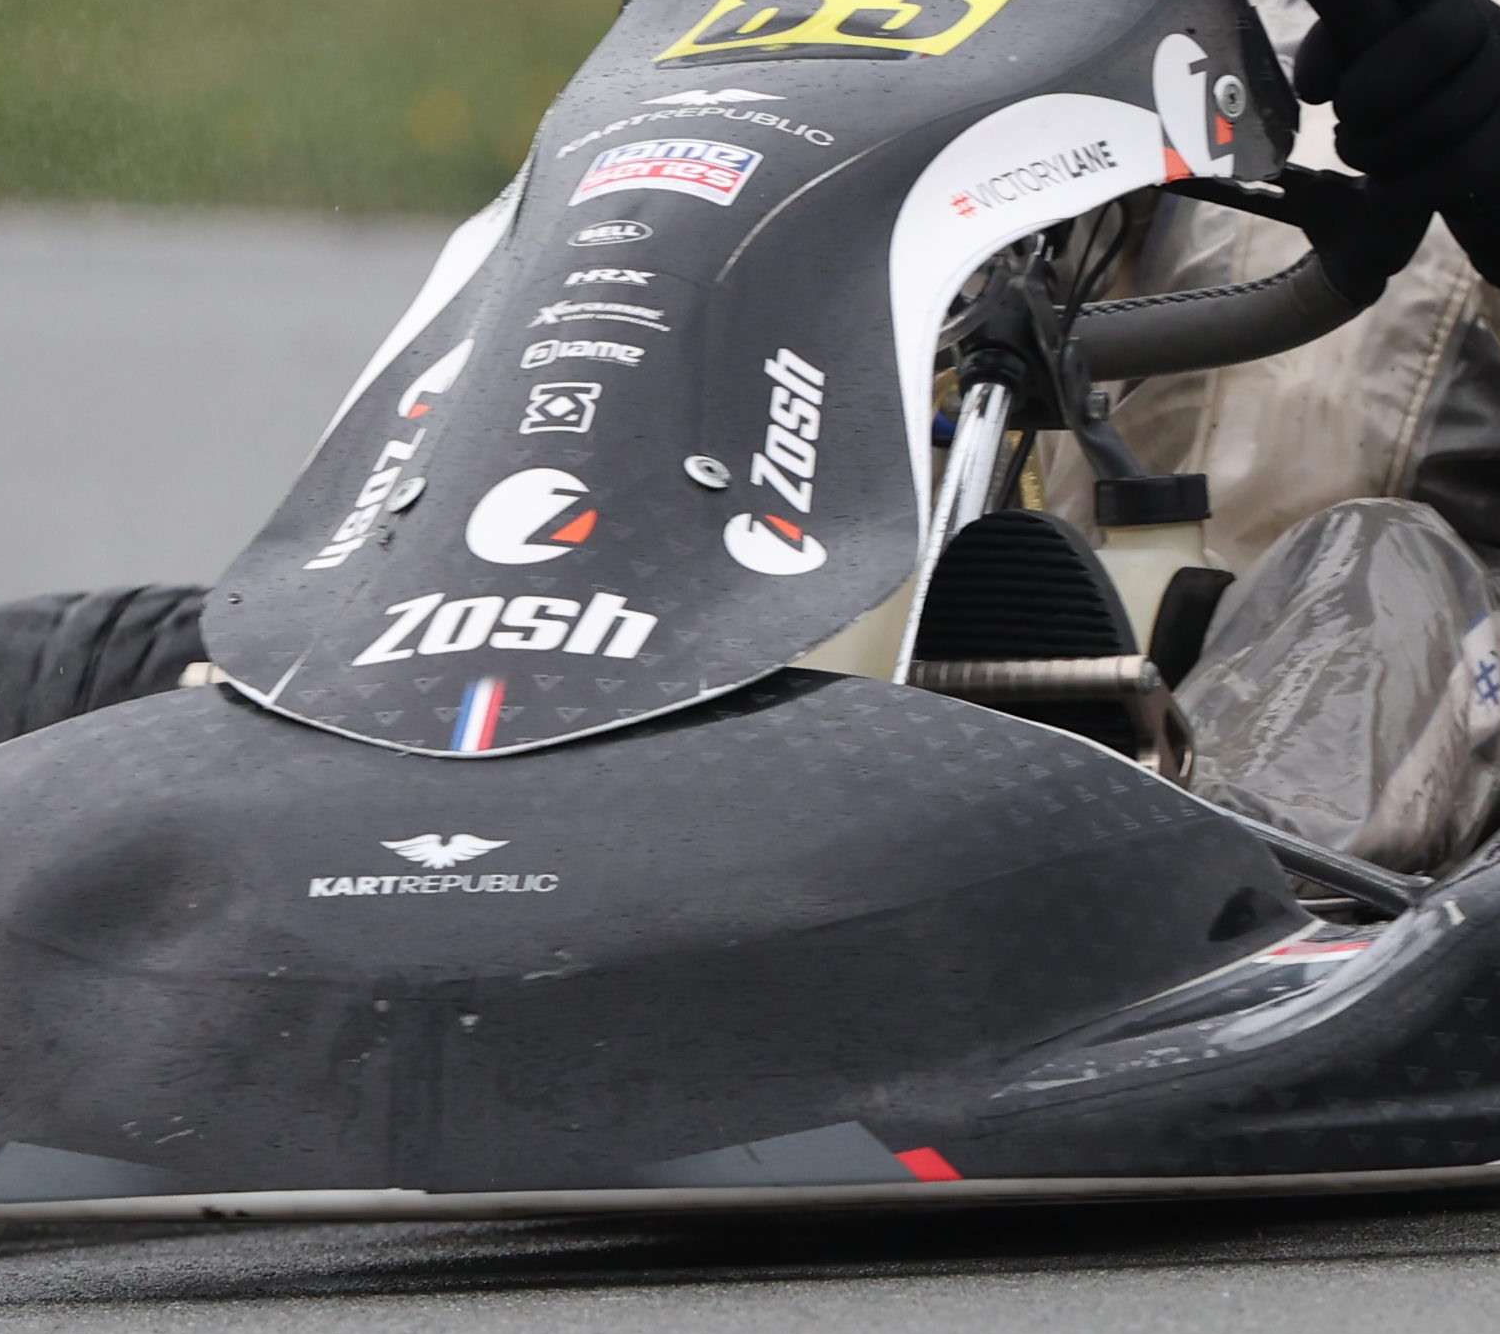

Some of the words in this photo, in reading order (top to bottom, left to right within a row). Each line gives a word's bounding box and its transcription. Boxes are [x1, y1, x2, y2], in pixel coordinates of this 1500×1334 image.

[950, 140, 1118, 219] #VICTORYLANE
[578, 225, 641, 242] BELL
[750, 347, 825, 514] Zosh
[350, 592, 659, 667] Zosh
[308, 874, 560, 898] KARTREPUBLIC
